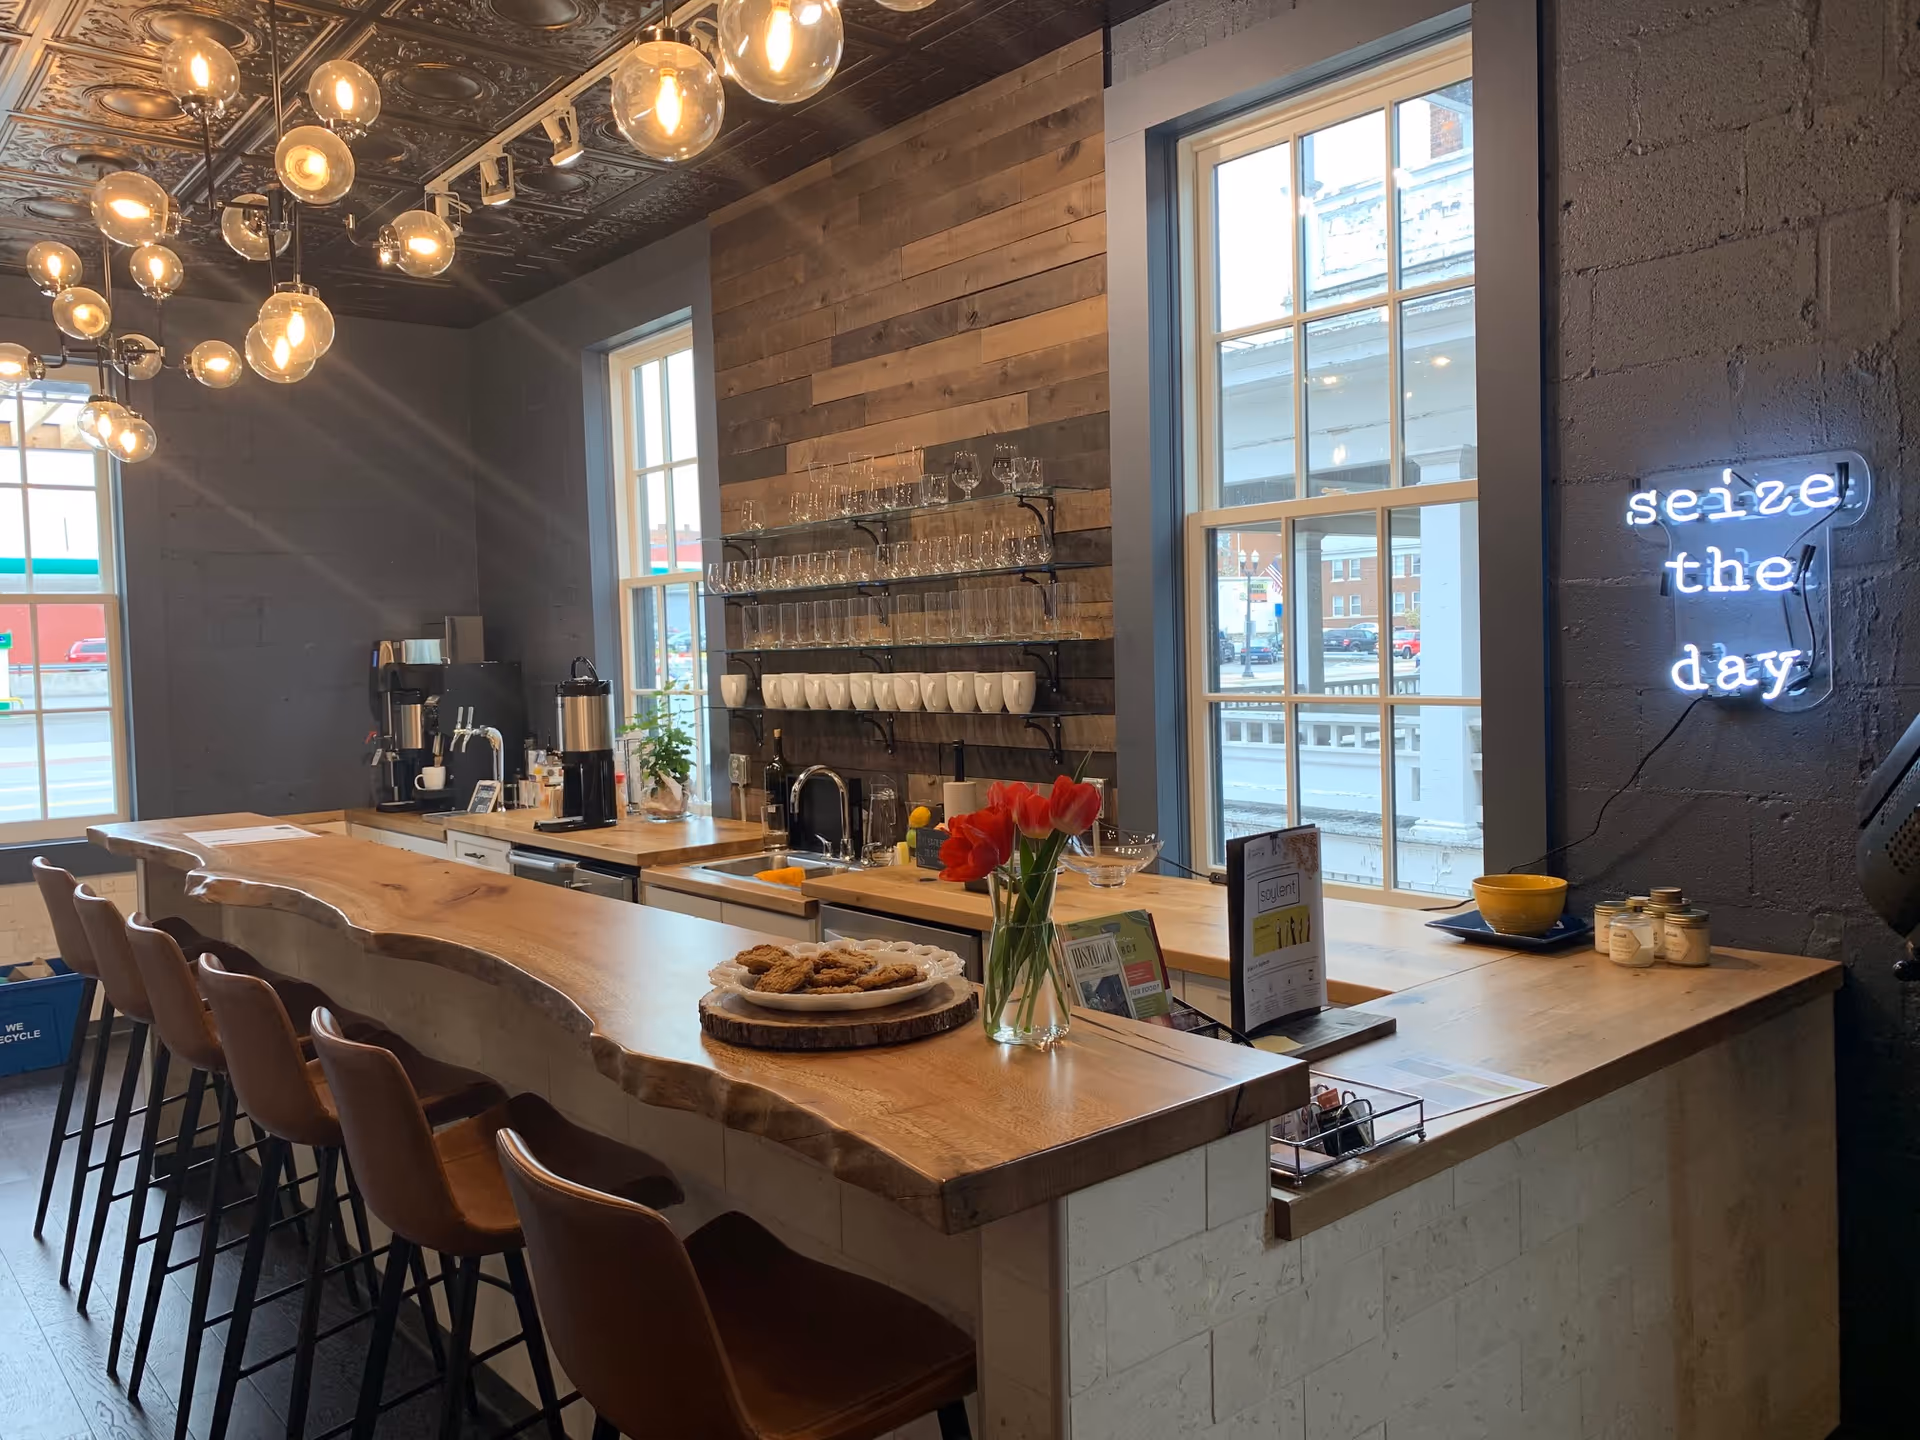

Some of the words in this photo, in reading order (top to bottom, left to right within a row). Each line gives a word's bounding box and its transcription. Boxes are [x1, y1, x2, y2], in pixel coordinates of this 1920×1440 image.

[1626, 467, 1839, 526] seize
[1664, 546, 1795, 594] the
[1671, 643, 1802, 700] day
[0, 1029, 41, 1044] ECYCLE
[5, 1022, 24, 1033] WE
